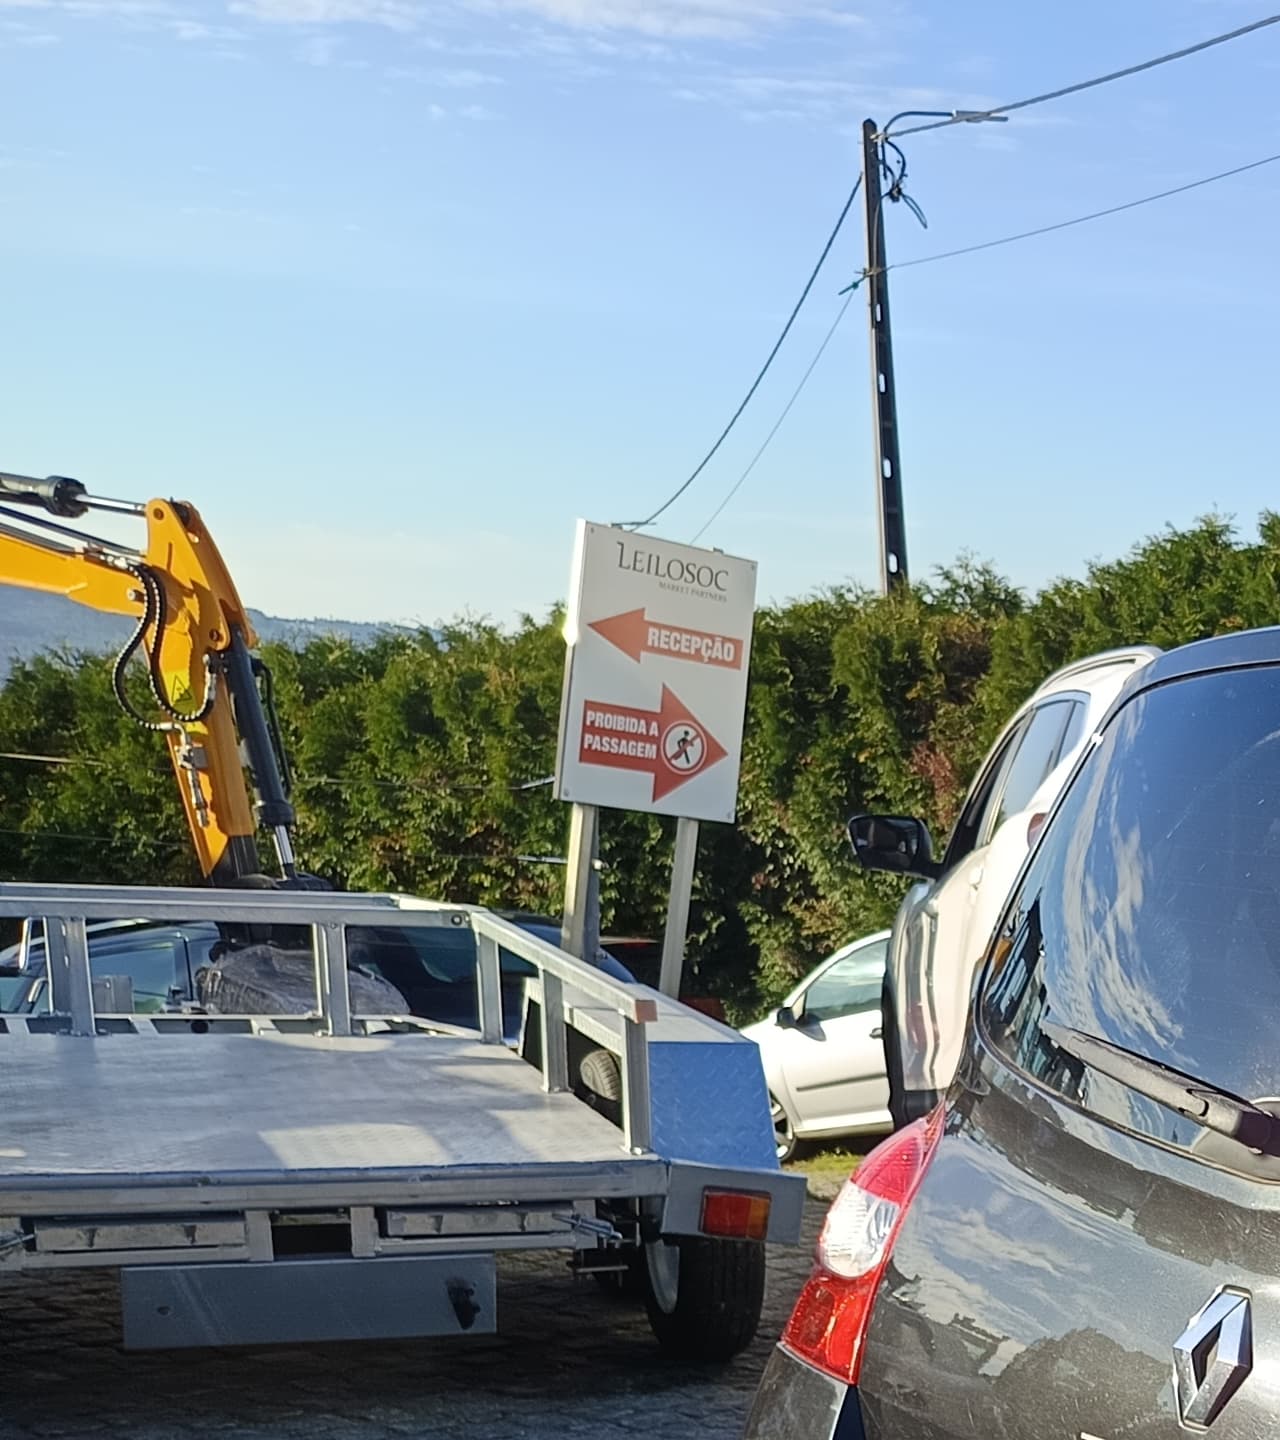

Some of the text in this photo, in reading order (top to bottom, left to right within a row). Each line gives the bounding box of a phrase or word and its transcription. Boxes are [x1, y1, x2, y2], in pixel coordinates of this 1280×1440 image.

[617, 541, 728, 591] LEILOSOC
[647, 627, 735, 662] RECEPÇÃO
[586, 710, 659, 737] PROIBIDA A
[583, 734, 657, 759] PASSAGEM
